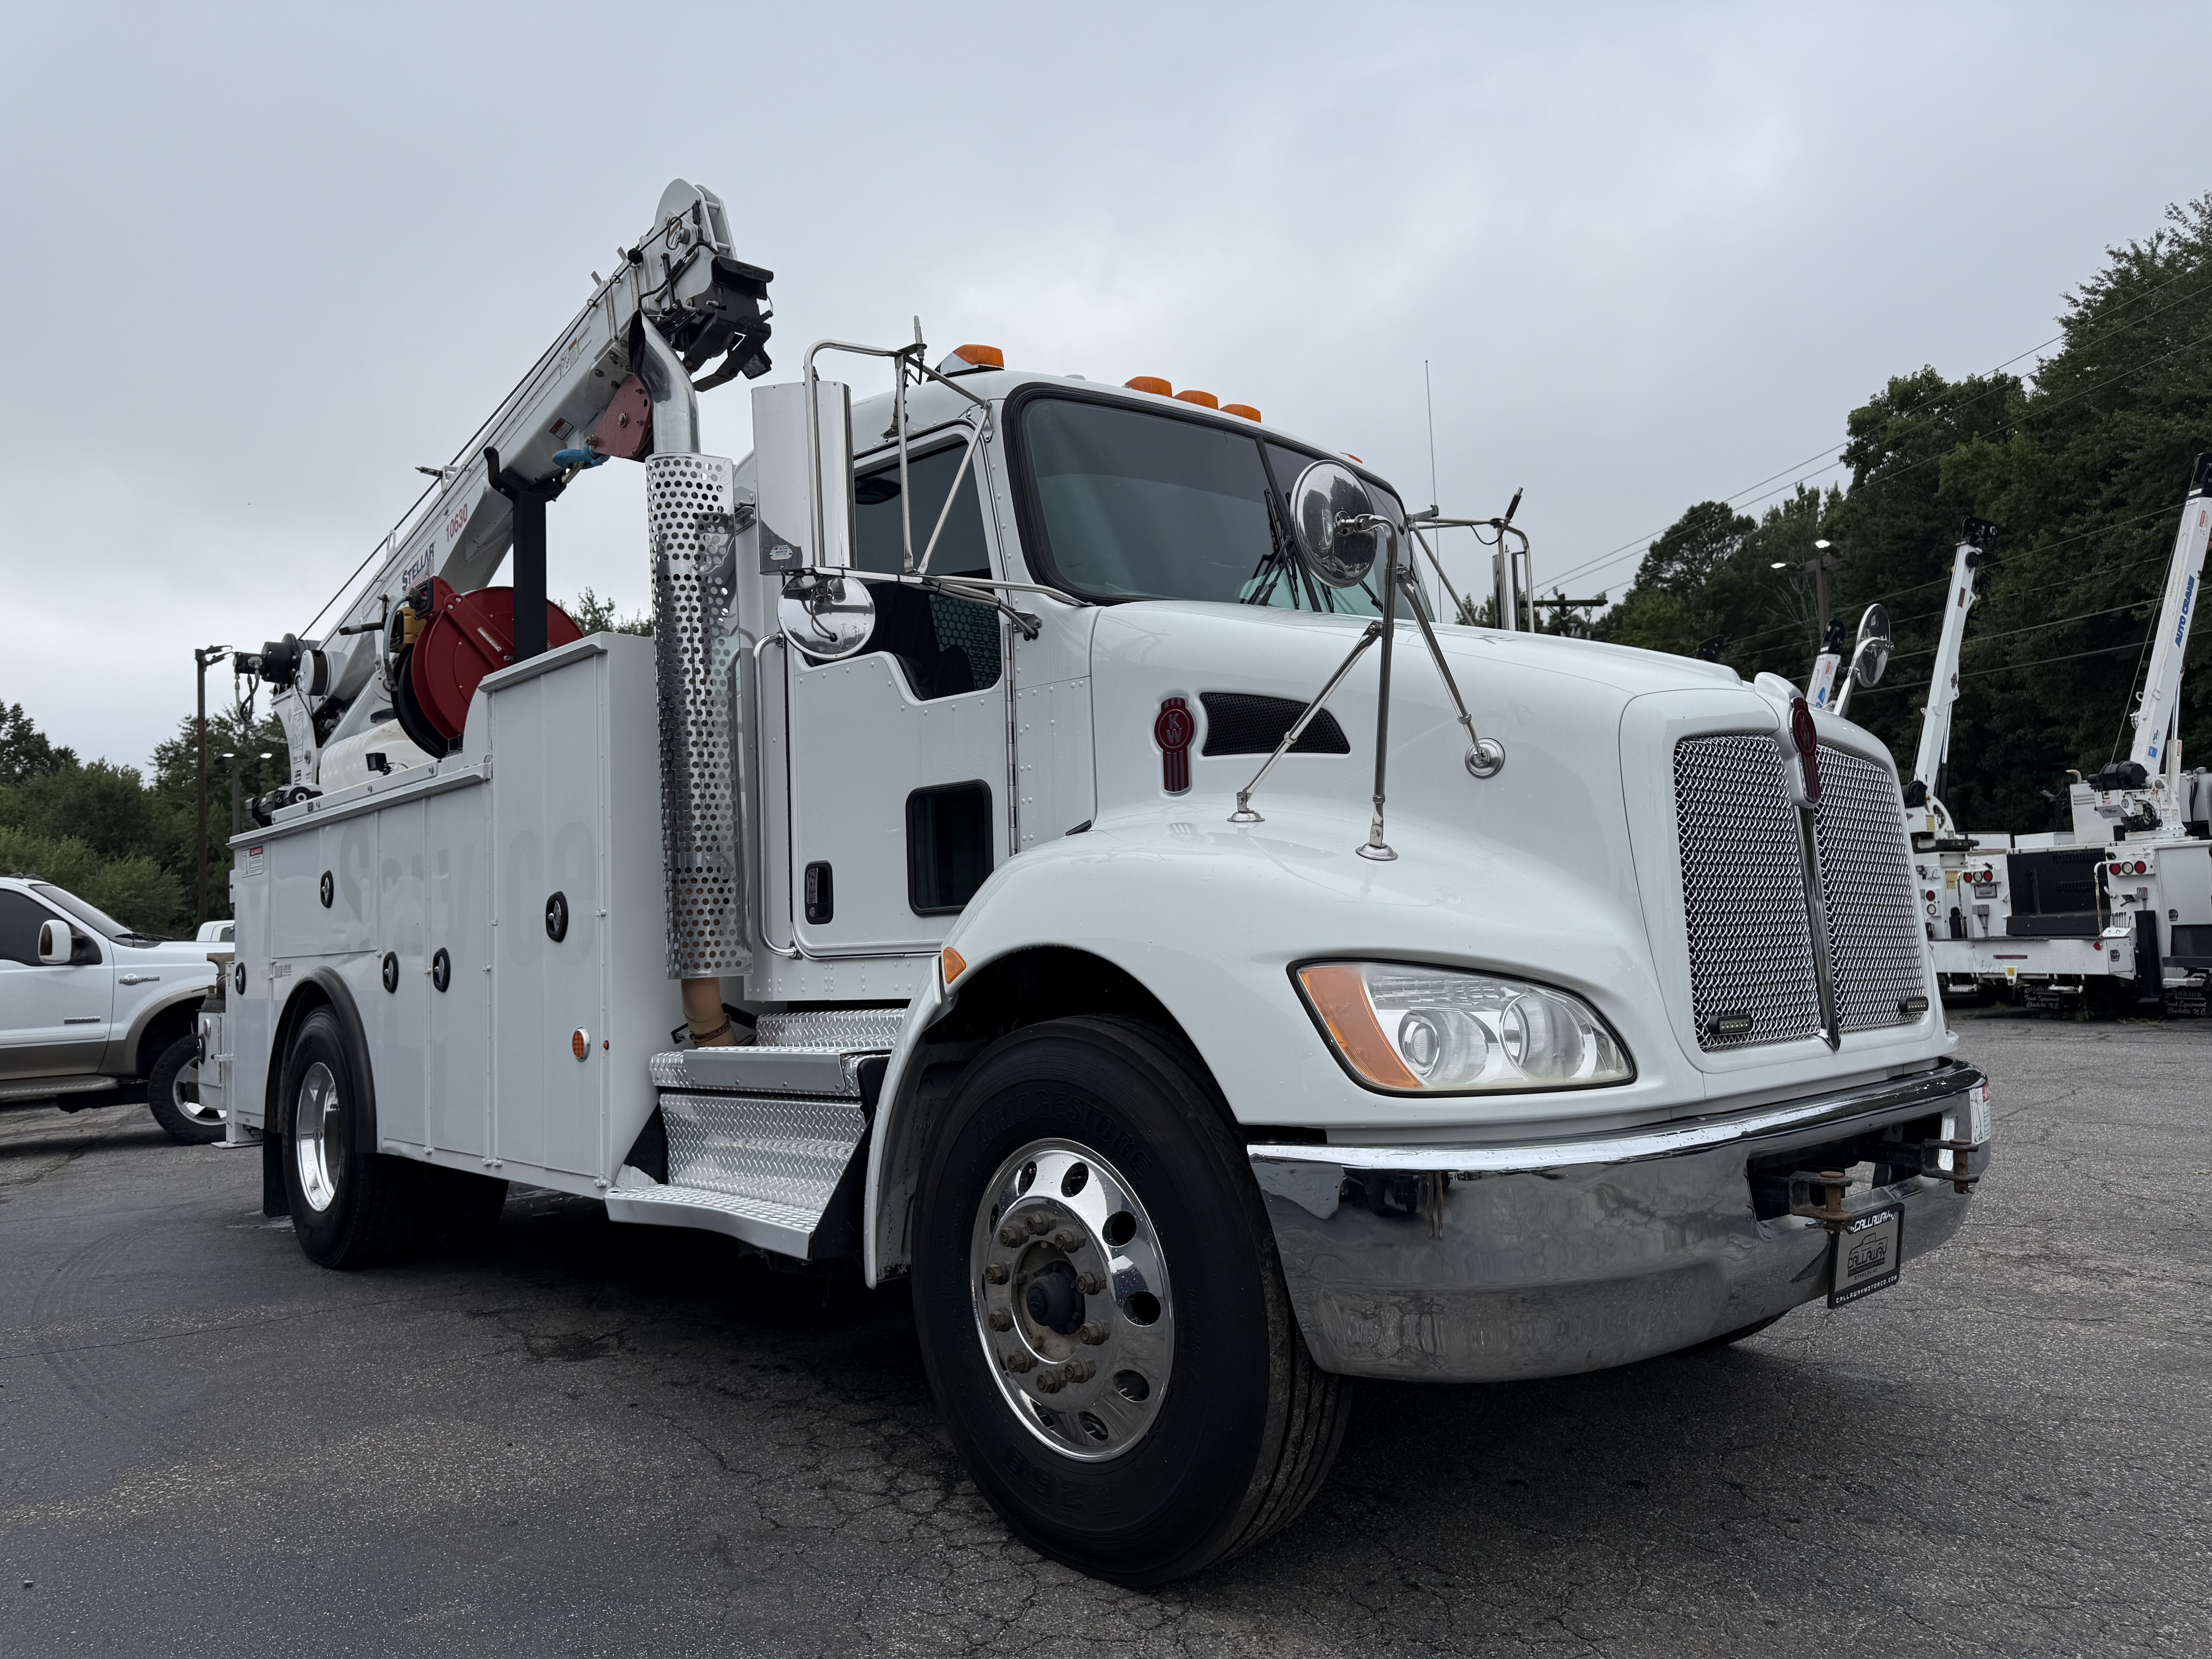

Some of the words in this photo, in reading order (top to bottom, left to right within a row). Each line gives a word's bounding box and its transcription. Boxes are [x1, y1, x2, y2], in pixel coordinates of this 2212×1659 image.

[446, 503, 467, 542] 10630
[402, 542, 434, 591] STELLAR
[2175, 615, 2186, 648] AUTO
[2182, 575, 2195, 615] CRANE
[1169, 713, 1180, 729] K
[1166, 728, 1183, 744] W
[1854, 1211, 1890, 1233] CALLAWAY
[1848, 1245, 1887, 1269] CALLAWAY
[1836, 1274, 1897, 1304] CALLAWAYMOTORCO.COM
